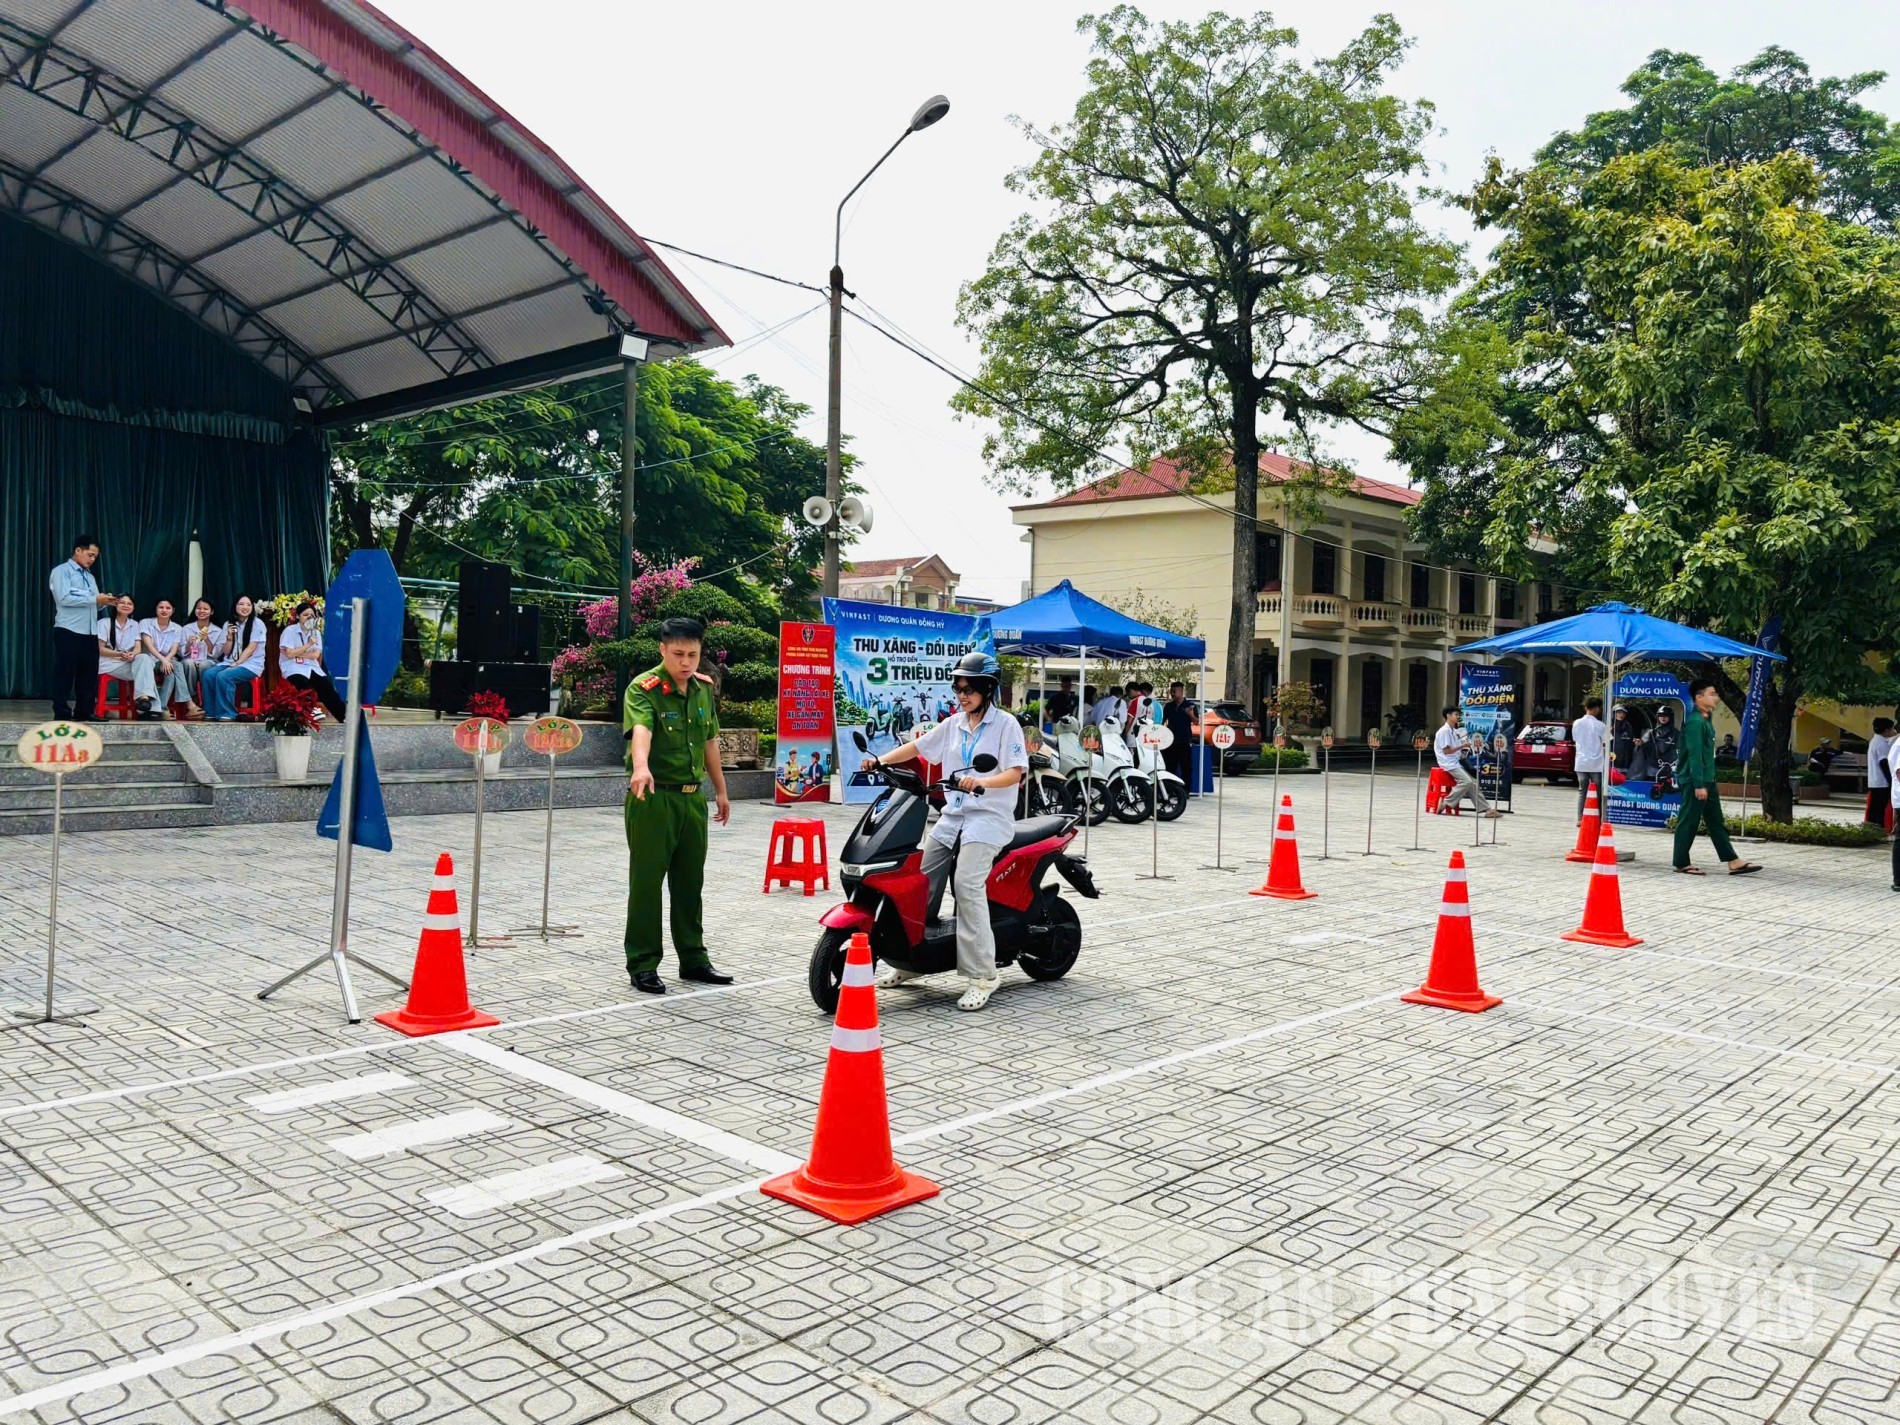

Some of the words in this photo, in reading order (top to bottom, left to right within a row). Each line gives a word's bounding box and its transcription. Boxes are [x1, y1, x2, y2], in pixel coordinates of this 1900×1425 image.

[840, 610, 870, 620] VINFAST
[878, 615, 900, 624] DƯƠNG
[854, 638, 879, 652] THU
[882, 637, 916, 654] XĂNG
[925, 638, 945, 656] ĐỔI
[783, 664, 810, 675] CHƯƠNG
[812, 664, 831, 675] TRÌNH
[866, 658, 888, 684] 3
[891, 663, 932, 684] TRIỆU
[1467, 686, 1486, 695] THU
[1487, 684, 1513, 693] XĂNG
[1620, 686, 1651, 695] DƯƠNG
[1466, 694, 1486, 706] ĐỔI
[1487, 693, 1514, 705] ĐIỆN
[787, 711, 796, 719] XE
[536, 720, 570, 732] LỚP
[803, 720, 819, 730] TOÀN
[36, 724, 88, 740] LỚP
[1481, 764, 1490, 775] 3
